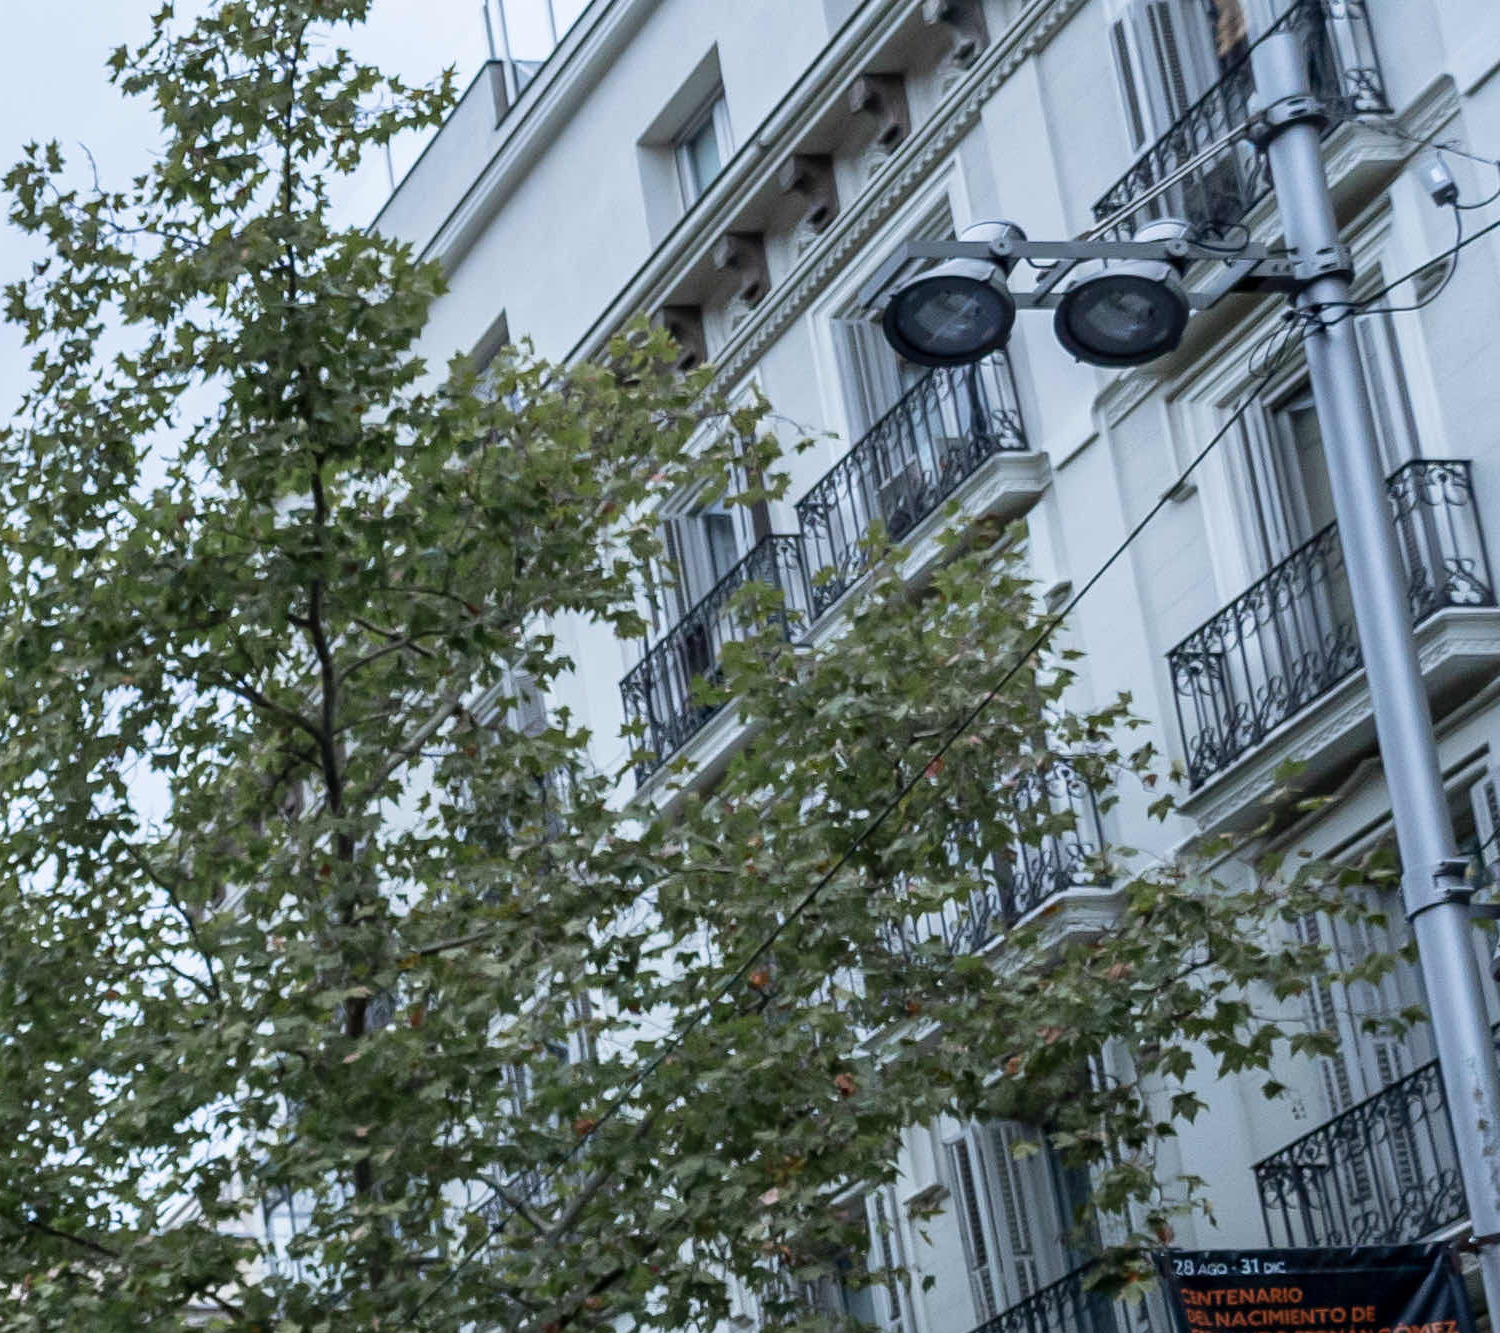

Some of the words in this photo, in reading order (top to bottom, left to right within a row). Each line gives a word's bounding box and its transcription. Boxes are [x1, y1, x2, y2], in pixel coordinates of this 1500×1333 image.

[1240, 1258, 1259, 1274] 31
[1264, 1261, 1286, 1275] DIC
[1215, 1306, 1346, 1328] NACIMIENTO
[1351, 1306, 1377, 1323] DE
